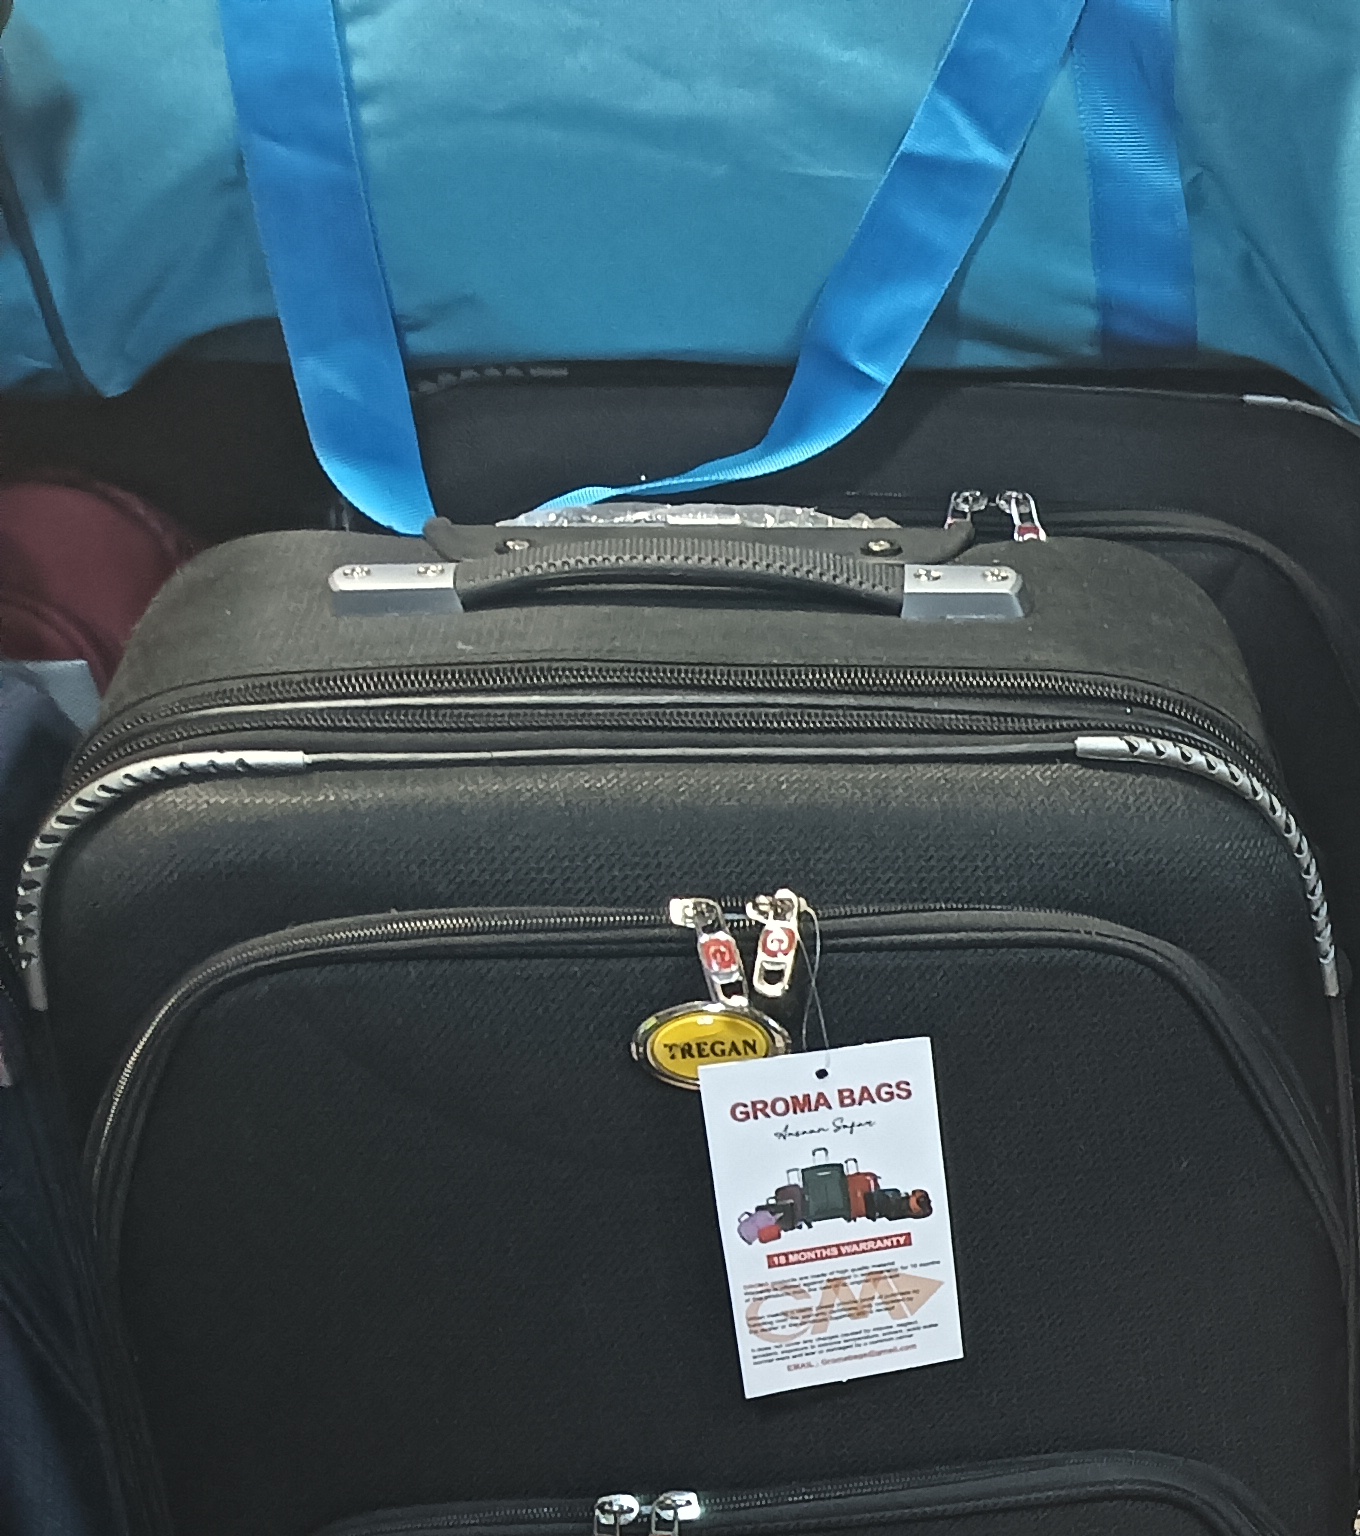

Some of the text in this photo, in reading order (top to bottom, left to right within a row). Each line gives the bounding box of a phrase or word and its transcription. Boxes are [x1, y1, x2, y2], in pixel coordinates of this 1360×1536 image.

[663, 1038, 758, 1060] TREGAN
[730, 1080, 913, 1123] GROMA BAGS
[788, 1247, 839, 1263] MONTHS
[839, 1235, 906, 1255] WARRANTY
